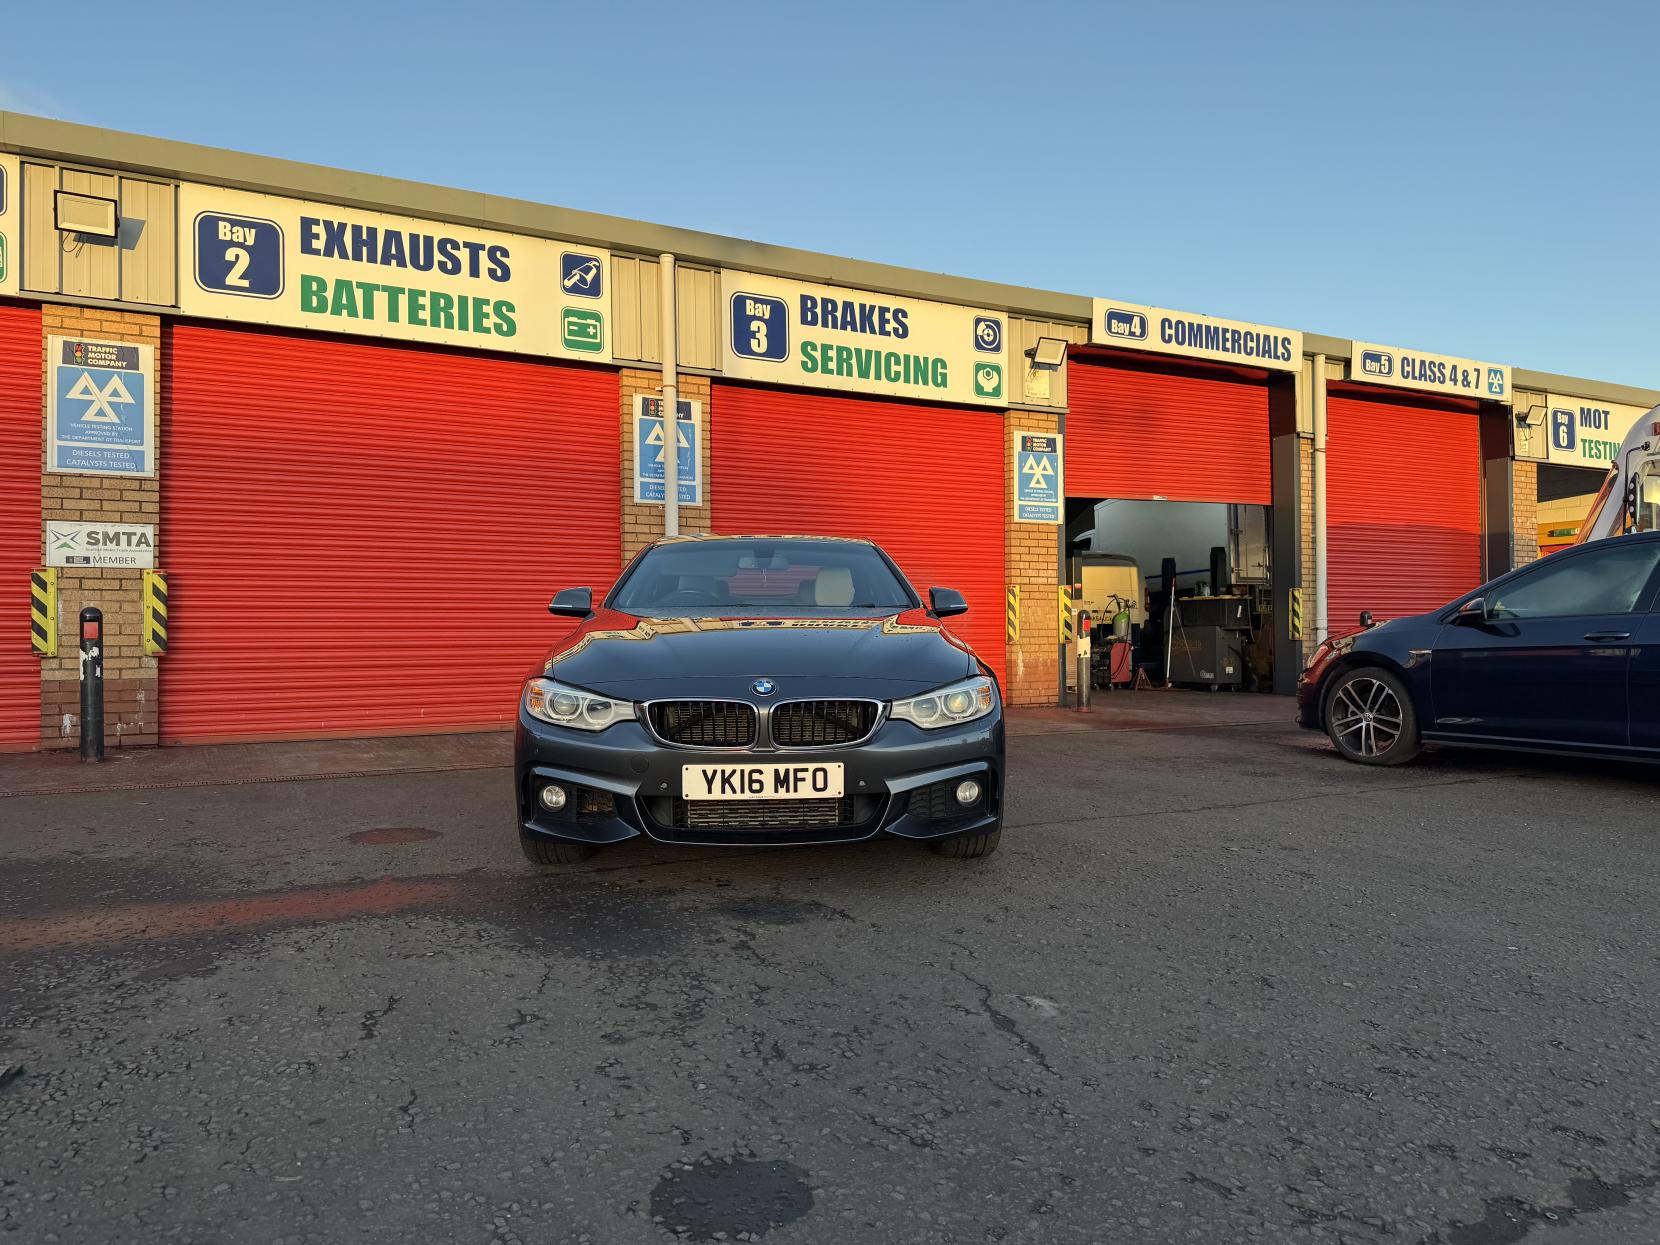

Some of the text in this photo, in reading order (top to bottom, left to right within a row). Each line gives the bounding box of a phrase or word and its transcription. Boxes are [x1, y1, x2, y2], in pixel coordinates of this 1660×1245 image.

[218, 221, 255, 246] Bay
[300, 216, 511, 283] EXHAUSTS
[224, 247, 251, 288] 2
[300, 273, 517, 337] BATTERIES
[745, 299, 771, 320] Bay
[799, 294, 909, 339] BRAKES
[1111, 315, 1142, 337] Bay 4
[750, 320, 768, 354] 3
[1160, 317, 1292, 362] COMMERCIALS
[87, 345, 118, 354] TRAFFIC
[87, 352, 117, 361] MOTOR
[87, 359, 127, 368] COMPANY
[800, 340, 948, 388] SERVICING
[1365, 355, 1389, 374] Bay 5
[1400, 356, 1481, 389] CLASS 4 & 7
[1557, 412, 1569, 424] Bay
[1580, 406, 1610, 430] MOT
[1559, 425, 1568, 447] 6
[72, 449, 130, 459] DIESELS TESTED
[1580, 438, 1620, 460] TESTIN
[66, 458, 136, 469] CATALYSTS TESTED
[85, 530, 152, 548] SMTA
[92, 555, 137, 565] MEMBER
[701, 767, 828, 795] YK16 MFO
